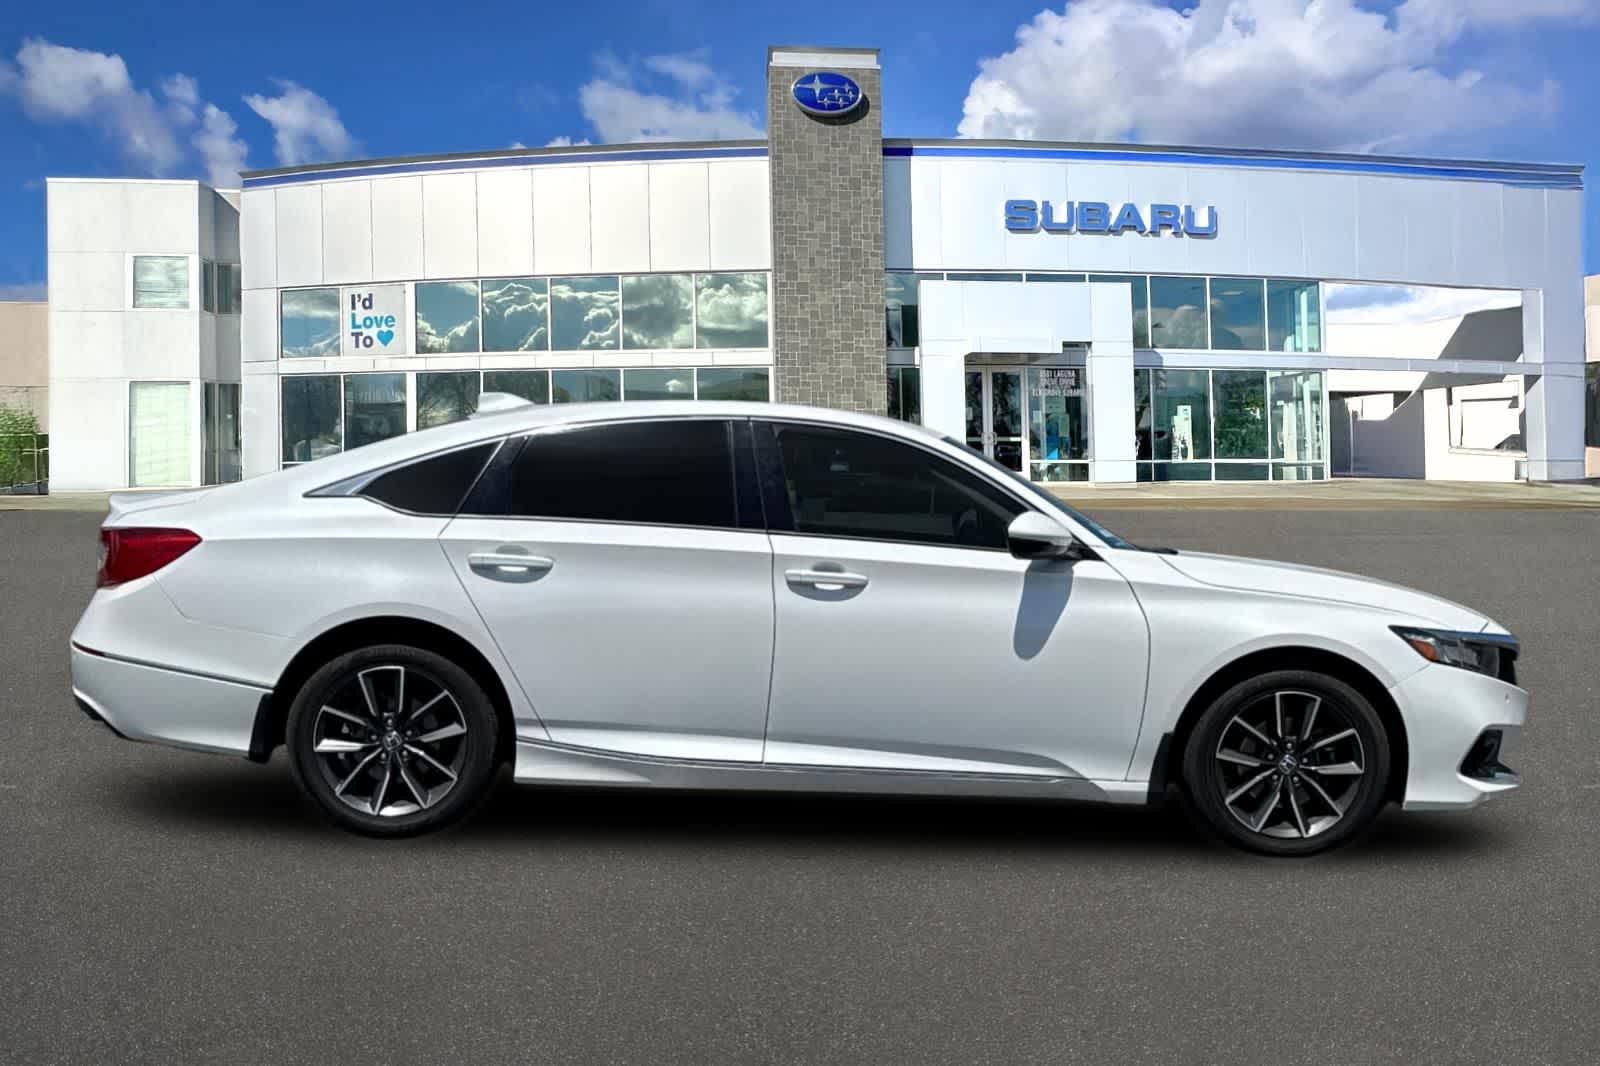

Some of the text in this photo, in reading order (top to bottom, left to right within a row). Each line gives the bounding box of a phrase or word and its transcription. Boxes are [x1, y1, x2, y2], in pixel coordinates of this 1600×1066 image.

[1005, 199, 1218, 238] SUBARU
[351, 293, 373, 311] I'd
[351, 312, 396, 330] Love
[351, 332, 374, 349] To
